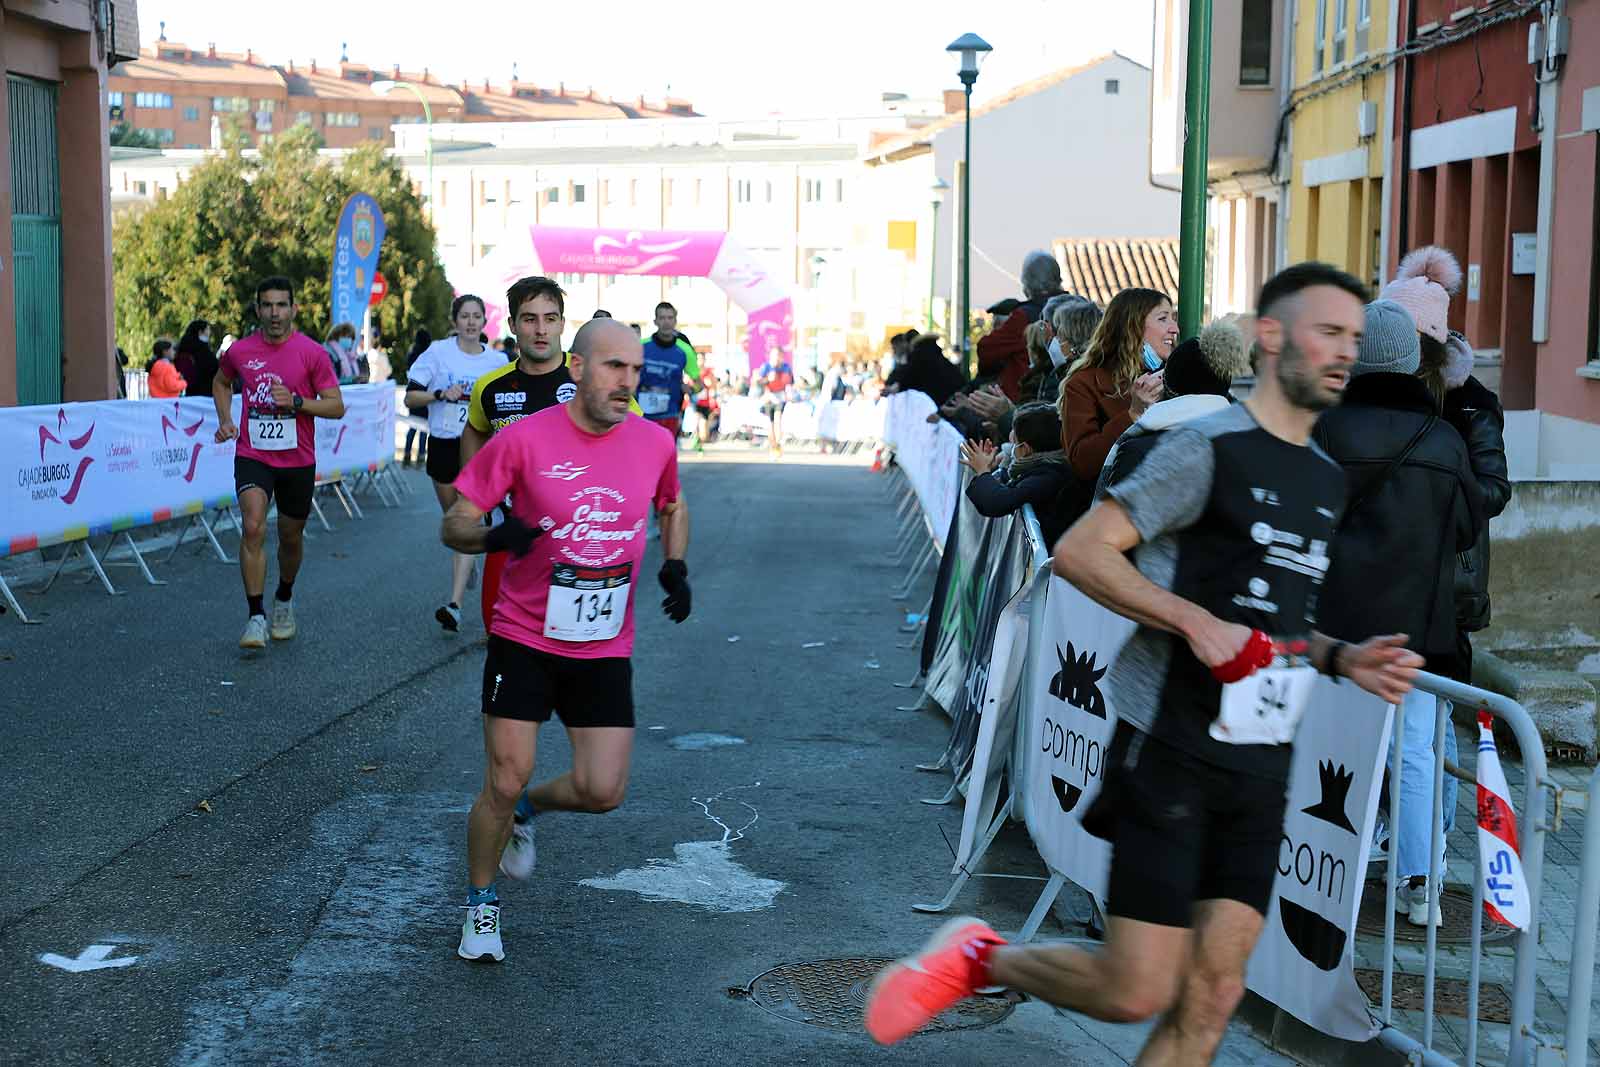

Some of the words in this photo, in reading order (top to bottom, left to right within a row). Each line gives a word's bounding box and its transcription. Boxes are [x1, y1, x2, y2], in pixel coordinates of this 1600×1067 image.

[259, 422, 284, 439] 222
[18, 463, 71, 489] CAJADEBURGOS
[574, 592, 613, 622] 134
[1277, 833, 1346, 905] com
[1486, 850, 1514, 907] rfs
